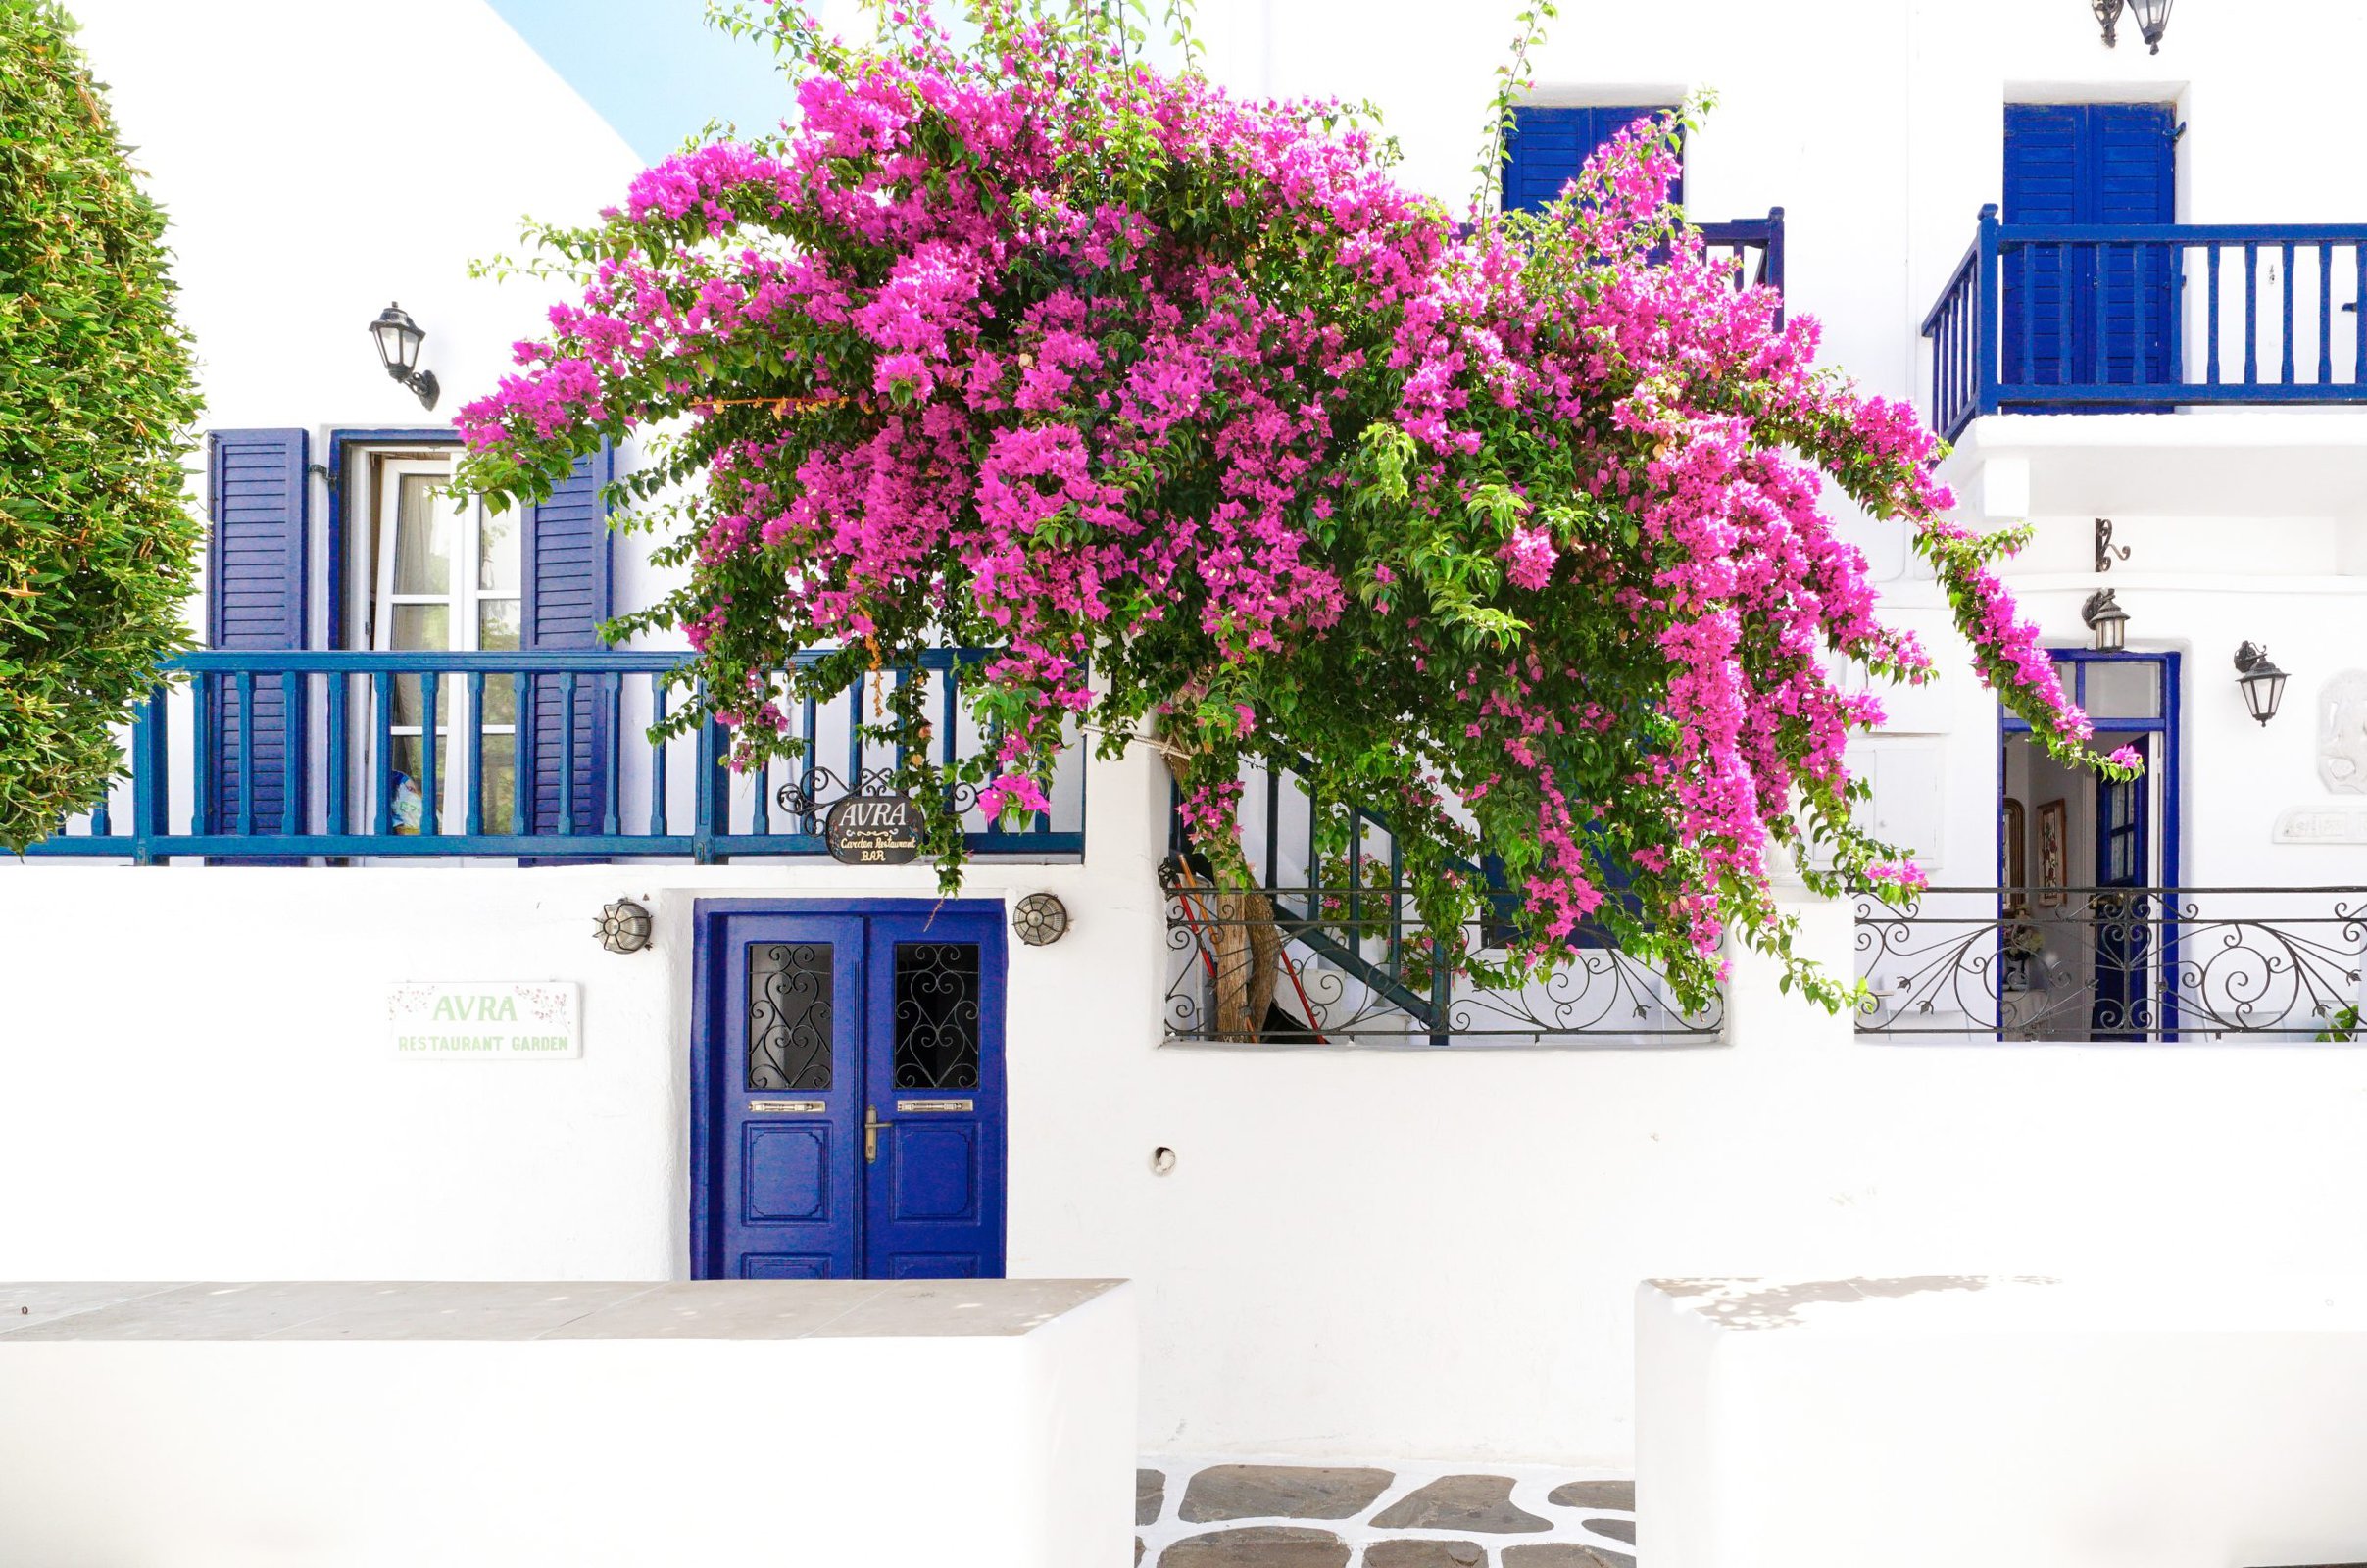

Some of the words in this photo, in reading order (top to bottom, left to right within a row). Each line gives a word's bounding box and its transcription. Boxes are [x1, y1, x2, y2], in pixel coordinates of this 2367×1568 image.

[839, 802, 907, 826] AVRA
[875, 835, 916, 849] Restaurant
[861, 850, 886, 862] BAR
[432, 995, 518, 1021] AVRA
[398, 1036, 504, 1052] RESTAURANT
[512, 1036, 568, 1052] GARDEN
